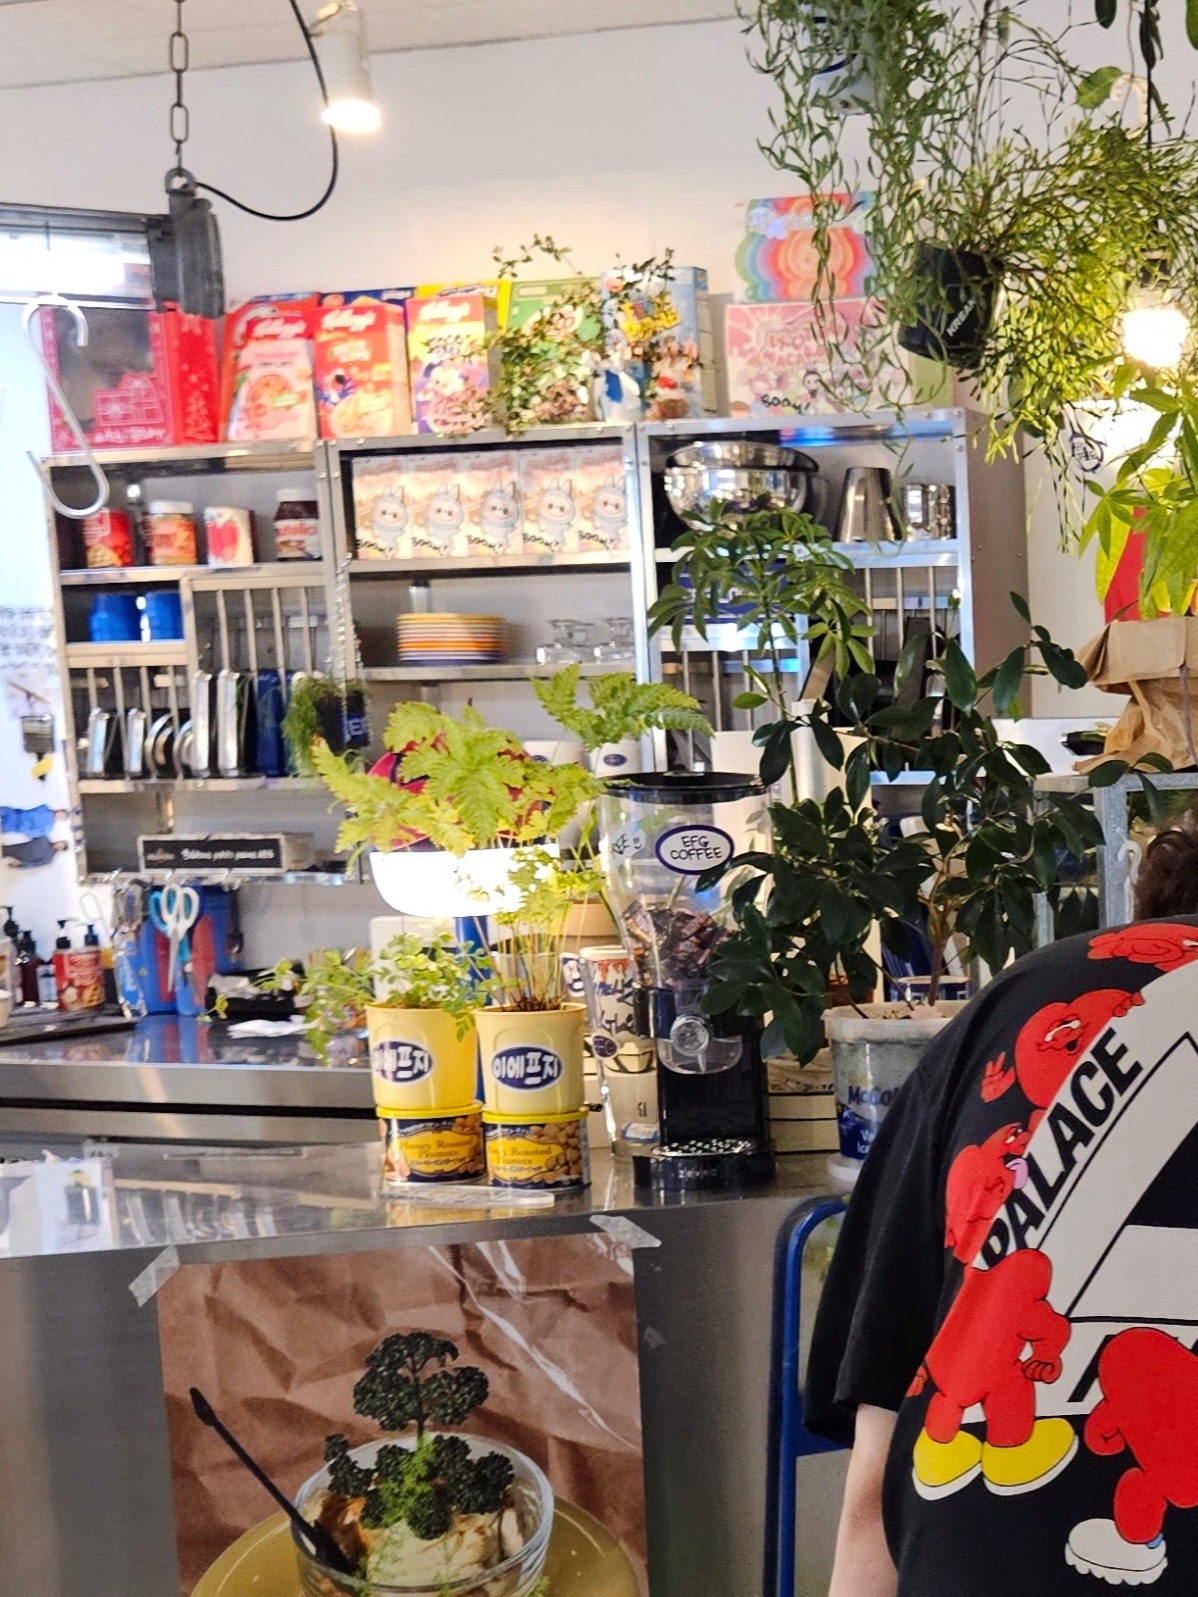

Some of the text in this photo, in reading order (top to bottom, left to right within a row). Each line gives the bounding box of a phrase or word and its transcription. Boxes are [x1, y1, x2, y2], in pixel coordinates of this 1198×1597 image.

[681, 835, 710, 848] EFG
[669, 847, 723, 861] COFFEE
[492, 1051, 559, 1085] 이에프지
[510, 1147, 552, 1157] Roasted
[976, 1028, 1143, 1269] PALACE
